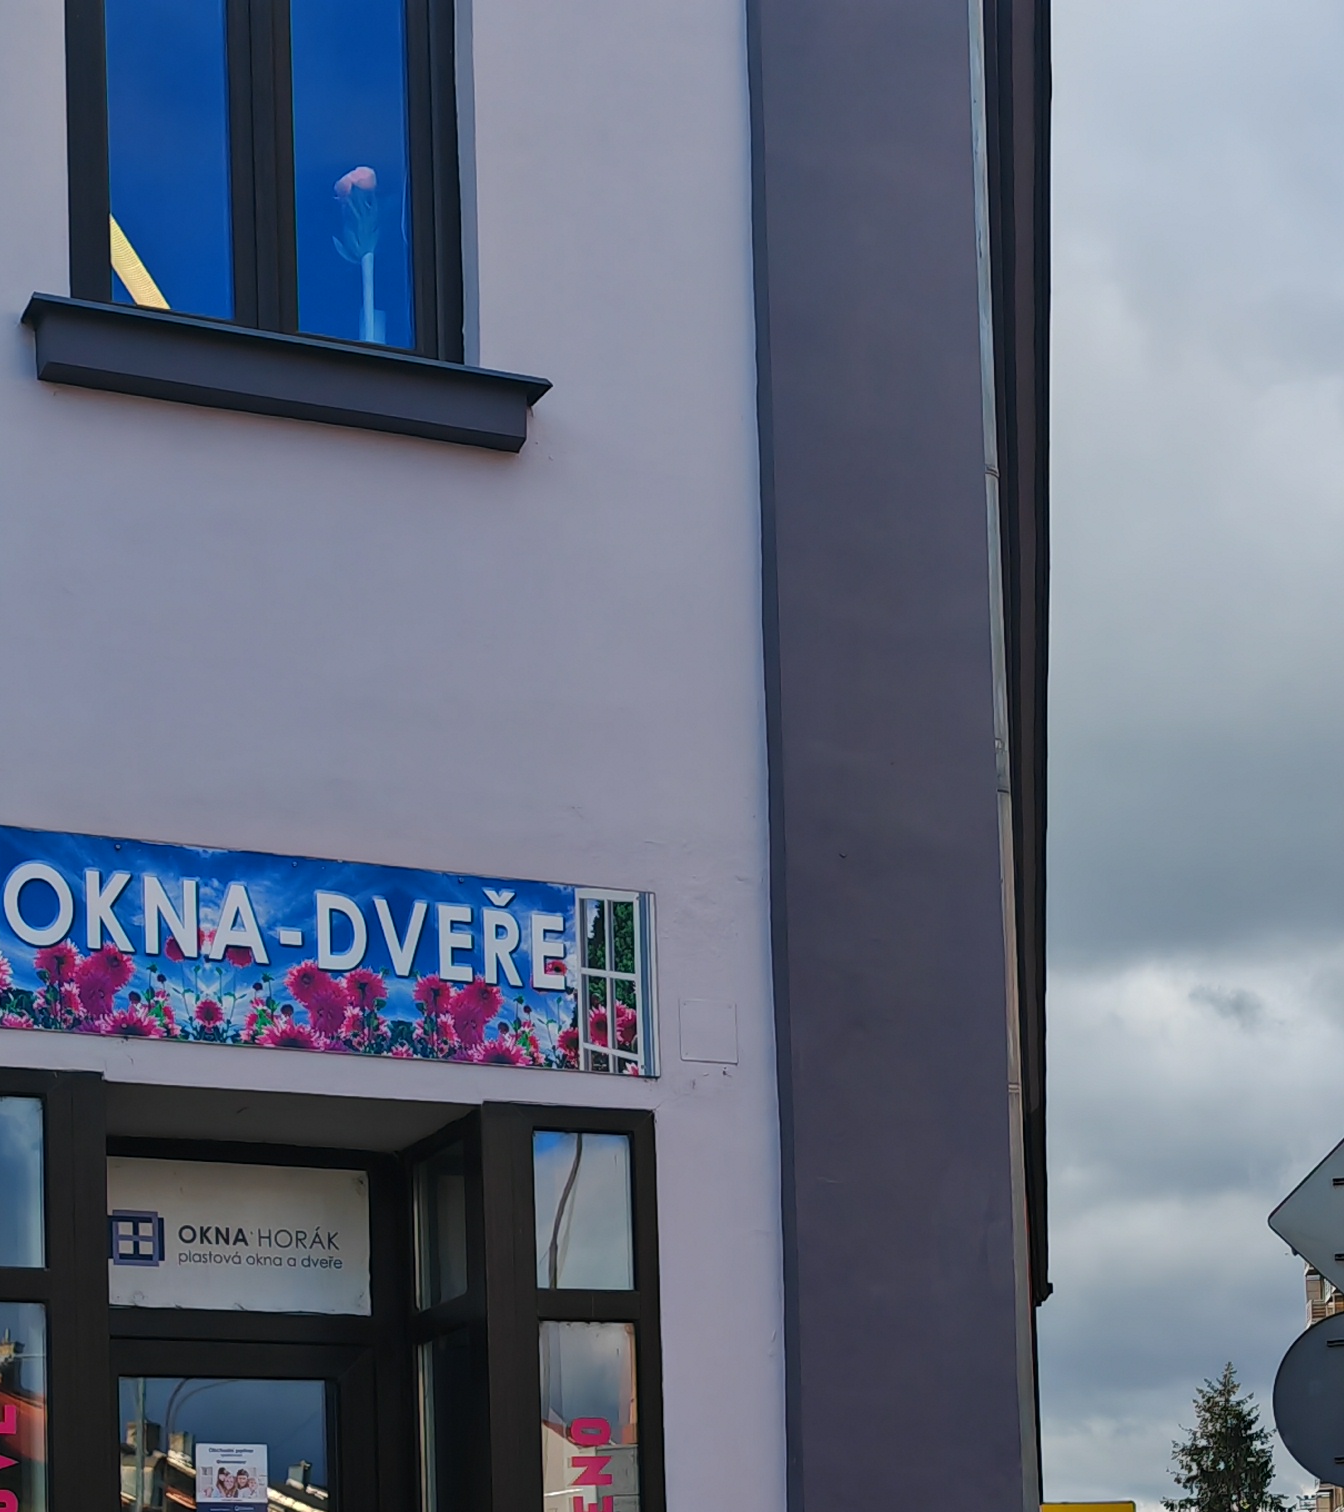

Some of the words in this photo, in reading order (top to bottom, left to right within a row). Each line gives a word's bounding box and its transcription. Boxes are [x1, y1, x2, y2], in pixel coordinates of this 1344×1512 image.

[2, 861, 571, 992] OKNA-DVEŘE
[178, 1224, 249, 1247] OKNA
[258, 1226, 340, 1251] HORÁK
[178, 1250, 242, 1266] plastová
[246, 1252, 283, 1267] okna
[287, 1257, 297, 1268] a
[301, 1254, 343, 1270] dveře
